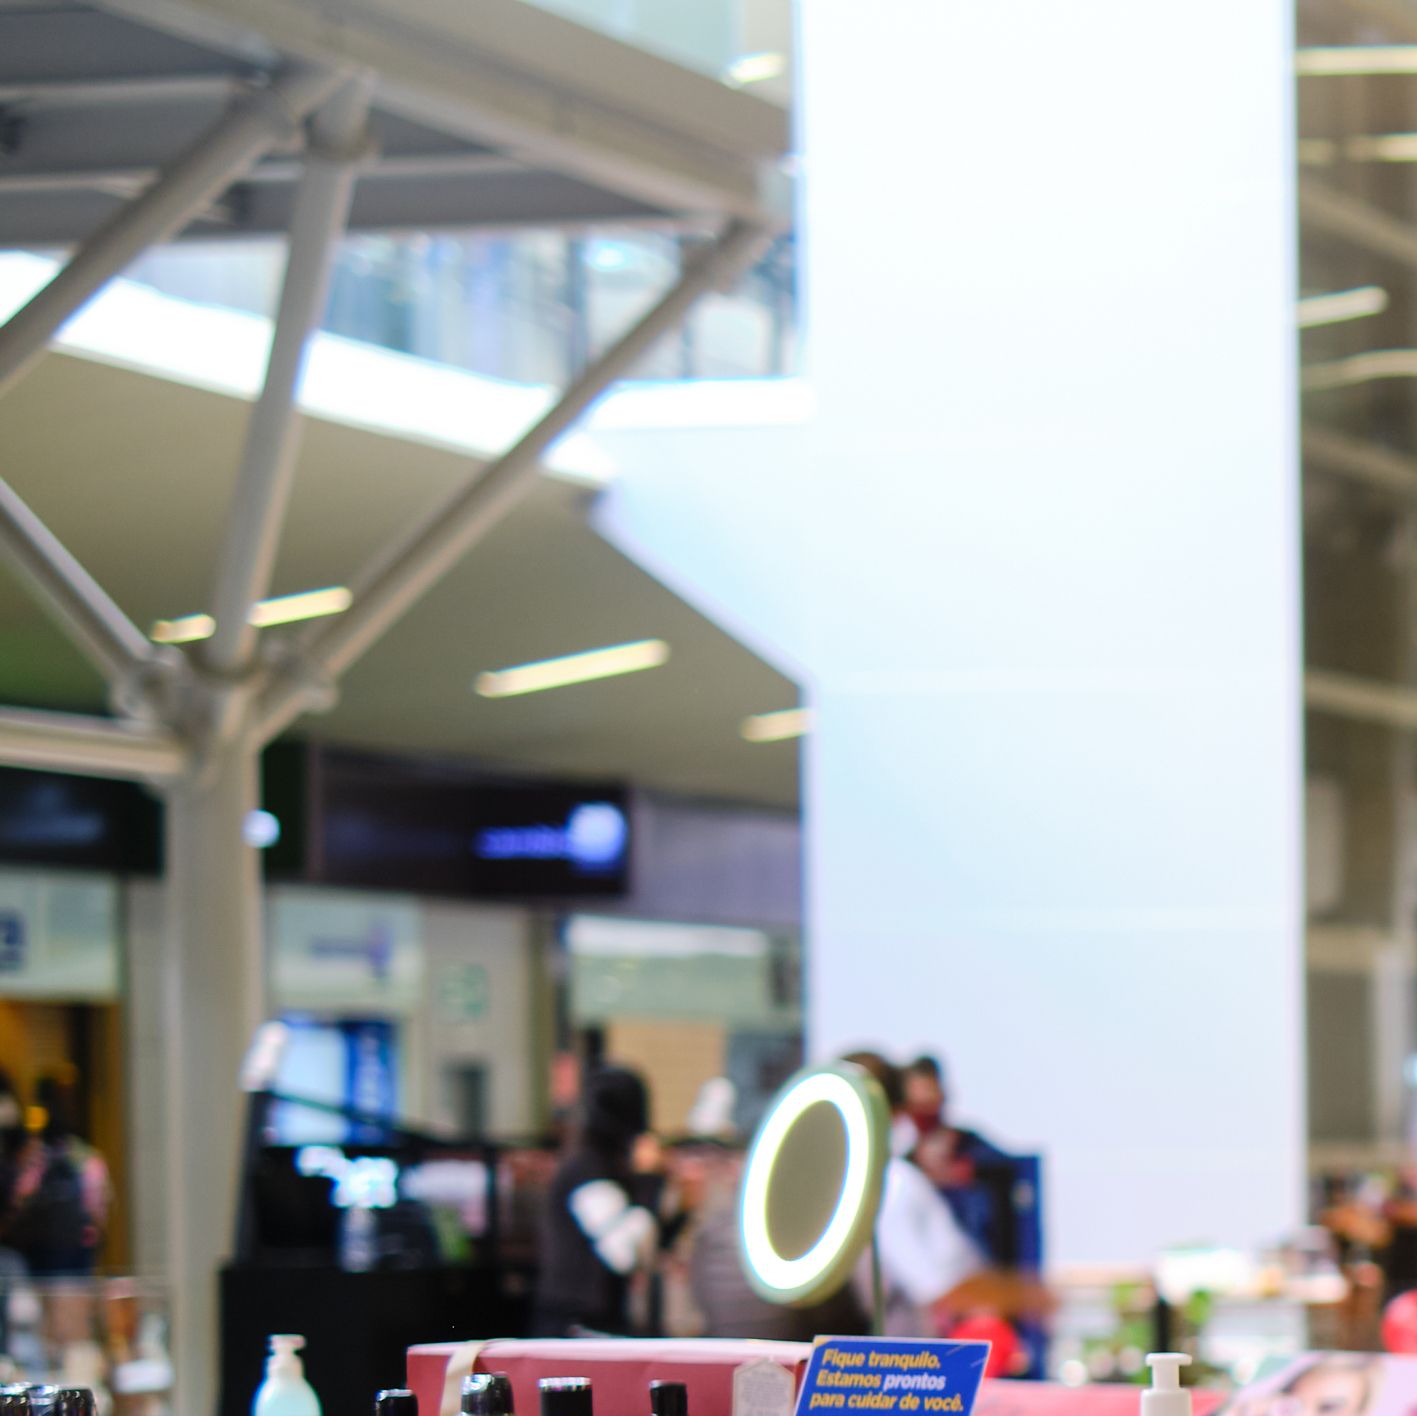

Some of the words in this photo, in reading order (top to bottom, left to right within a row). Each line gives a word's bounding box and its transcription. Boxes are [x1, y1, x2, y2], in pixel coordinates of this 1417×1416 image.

[823, 1350, 864, 1368] Fique
[868, 1349, 941, 1369] tranquilo.
[816, 1370, 881, 1388] Estamos
[883, 1373, 946, 1391] prontos
[810, 1394, 844, 1409] para
[848, 1392, 896, 1409] cuidar
[900, 1394, 920, 1410] de
[923, 1394, 964, 1412] você.
